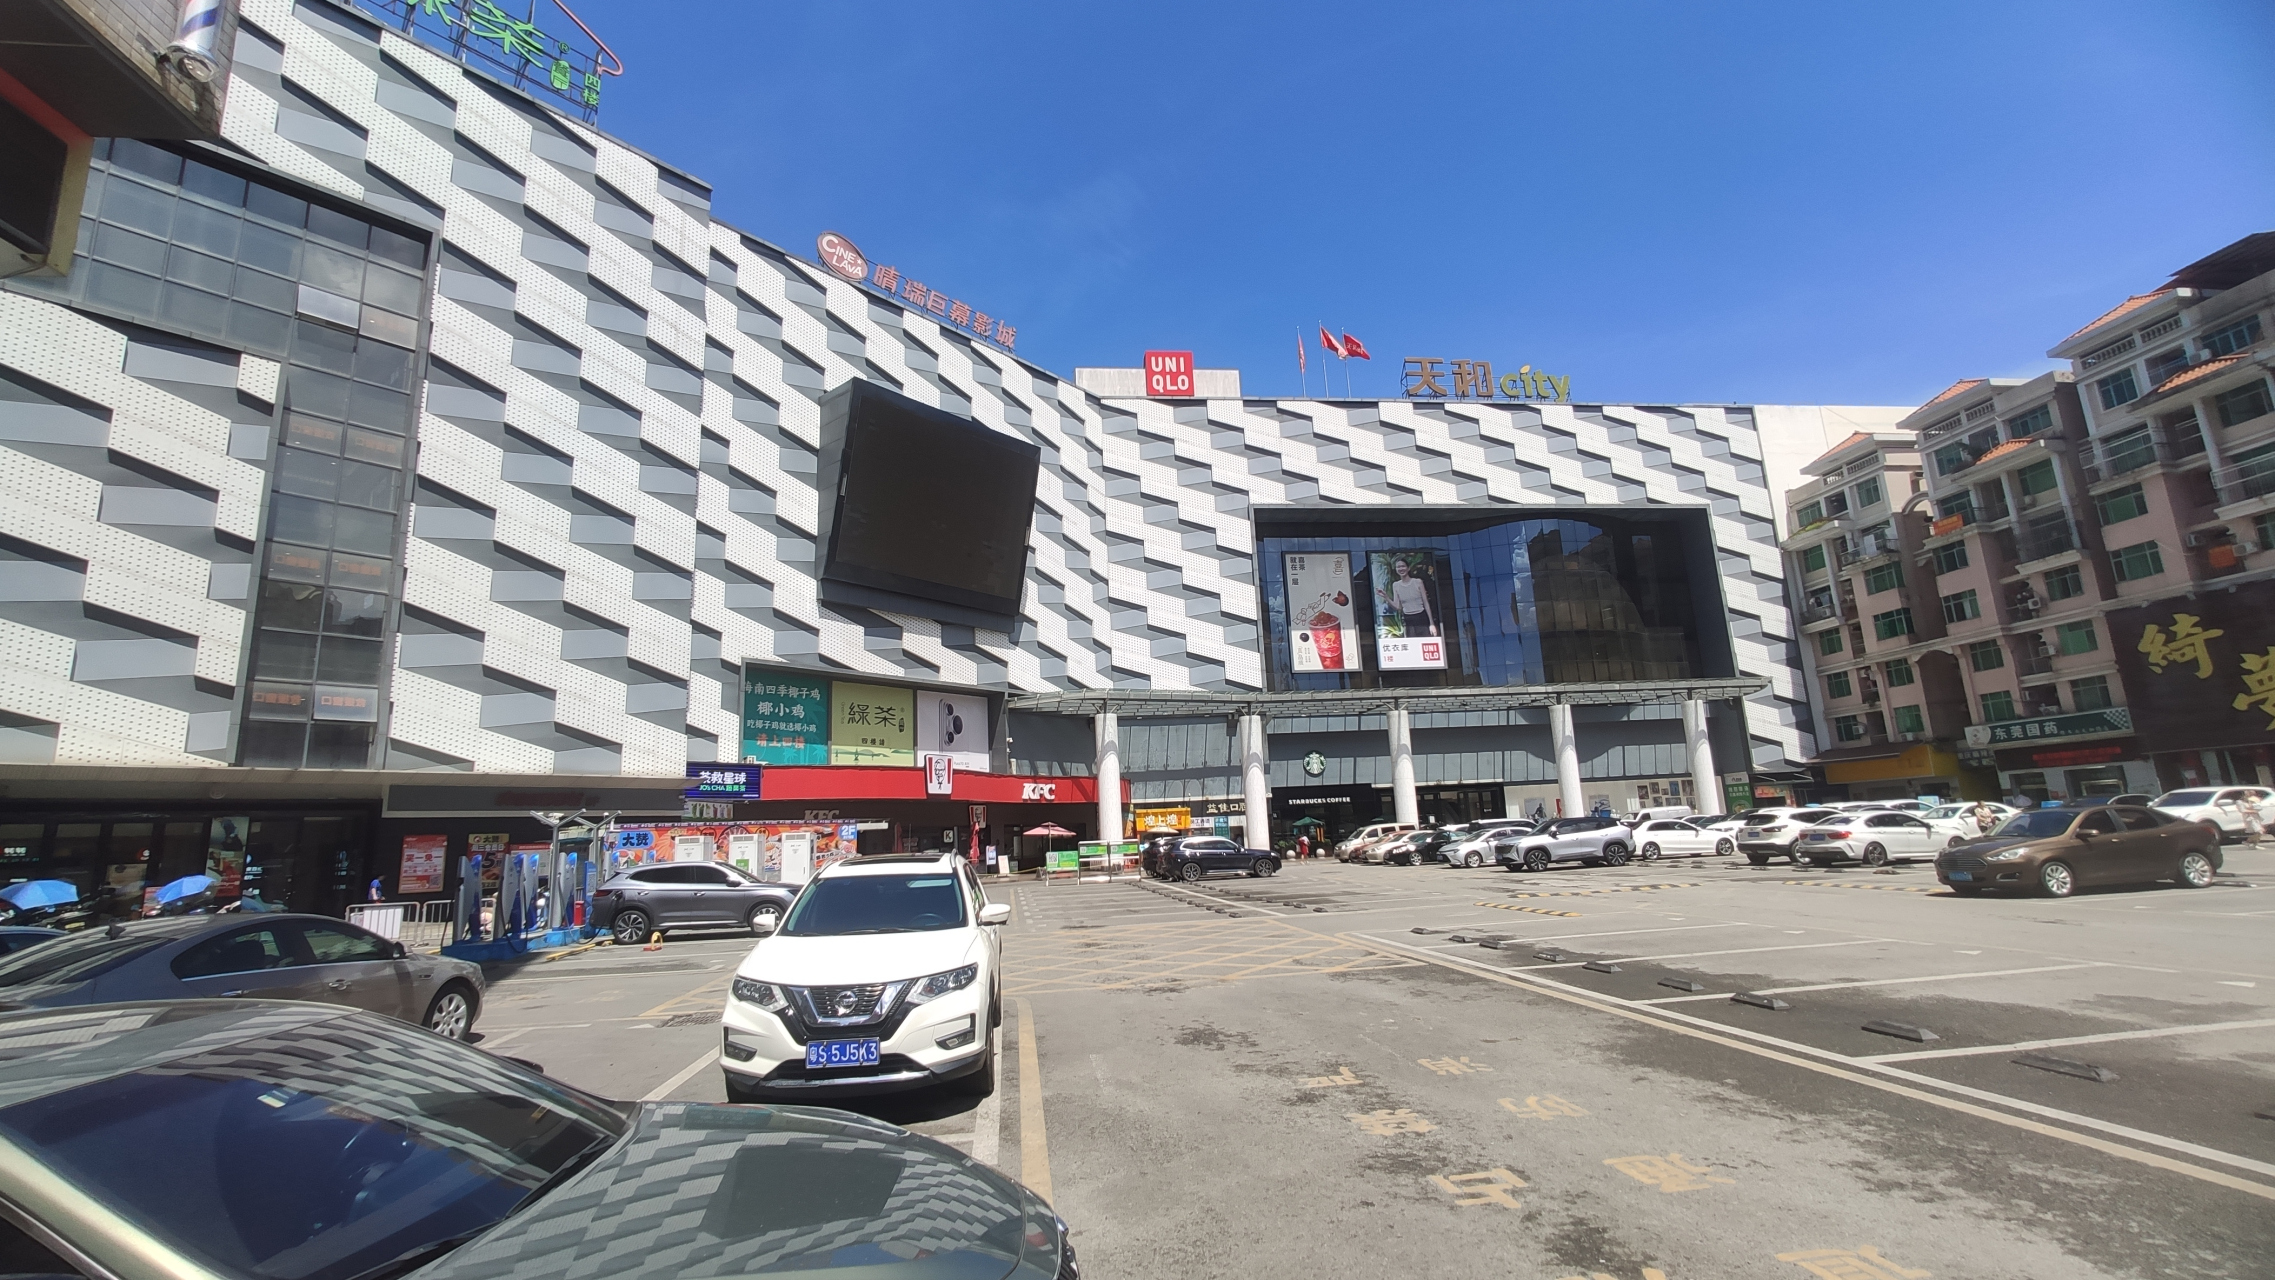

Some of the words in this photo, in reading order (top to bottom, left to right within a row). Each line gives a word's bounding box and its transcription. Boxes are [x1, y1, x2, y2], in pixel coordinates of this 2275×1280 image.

[583, 73, 601, 106] 四楼
[1151, 356, 1187, 373] UNI
[1152, 376, 1190, 394] QLO
[1404, 357, 1494, 397] 天和
[1500, 364, 1570, 402] city
[1382, 643, 1409, 652] 优衣库
[1424, 652, 1439, 660] QLO
[756, 701, 805, 719] 椰小鸡
[1994, 722, 2058, 740] 东莞国药
[1022, 783, 1056, 800] KFC
[1144, 814, 1178, 827] 煌上煌
[841, 825, 856, 836] 2F
